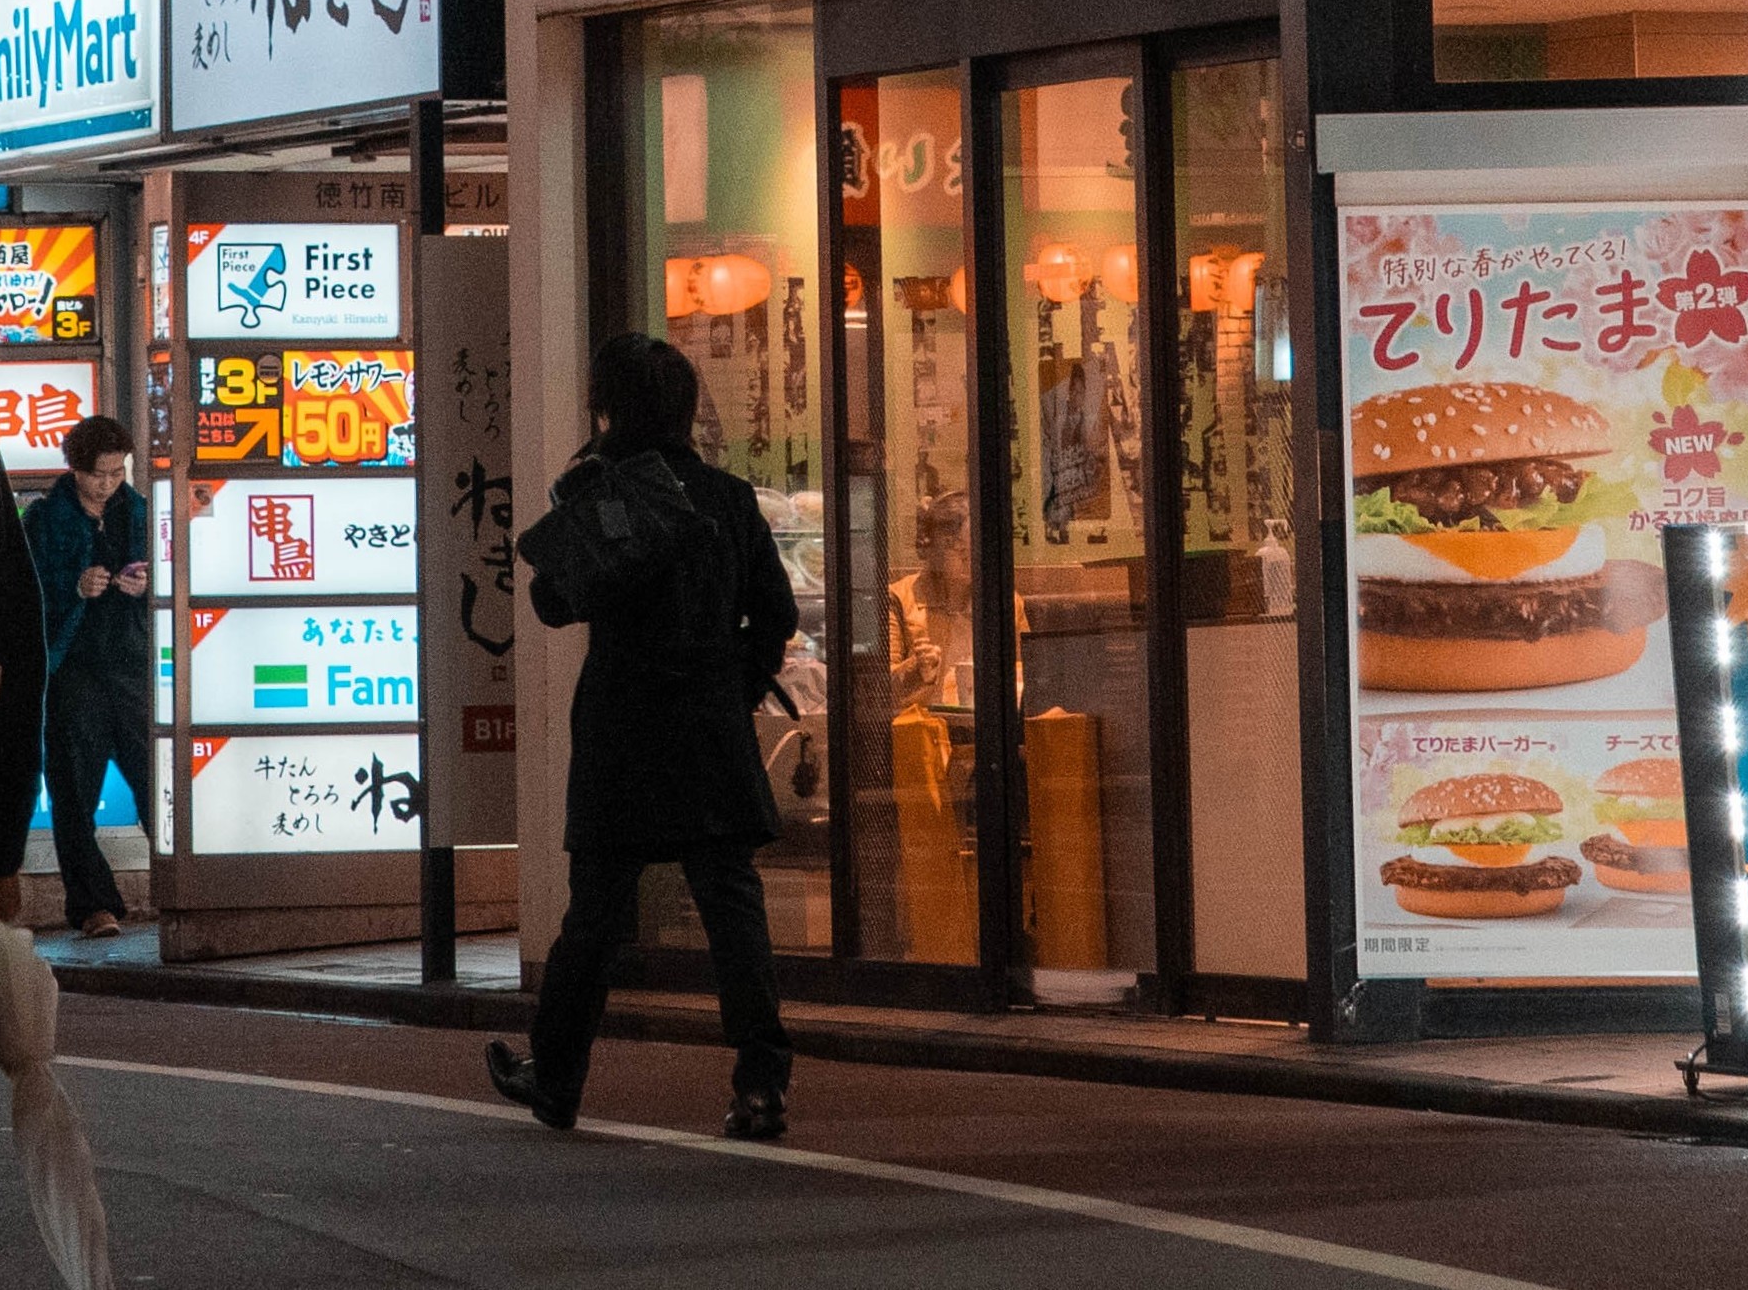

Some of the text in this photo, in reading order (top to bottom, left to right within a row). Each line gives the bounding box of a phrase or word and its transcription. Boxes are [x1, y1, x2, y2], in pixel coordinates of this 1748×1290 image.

[189, 21, 232, 71] 麦めし
[315, 181, 501, 211] 徳竹南ビル
[188, 230, 210, 245] 4F
[222, 247, 250, 261] First
[305, 242, 374, 272] First
[1380, 236, 1630, 287] 特別な春がやってくる!
[222, 261, 257, 273] Piece
[305, 277, 376, 300] Piece
[1674, 283, 1739, 312] 第2弾
[55, 310, 92, 339] 3F
[1357, 267, 1657, 376] てりたま
[292, 360, 404, 392] レモンサワー
[198, 412, 237, 426] 入口は
[295, 398, 383, 458] 50円
[198, 429, 237, 444] こちら
[1665, 434, 1715, 455] NEW
[1663, 486, 1726, 508] コク旨
[251, 497, 313, 579] 串鳥
[194, 613, 214, 628] 1F
[192, 742, 214, 758] B1
[253, 755, 317, 783] 牛たん
[288, 783, 341, 806] とろろ
[270, 813, 325, 836] 麦めし
[1363, 936, 1431, 954] 期間限定
